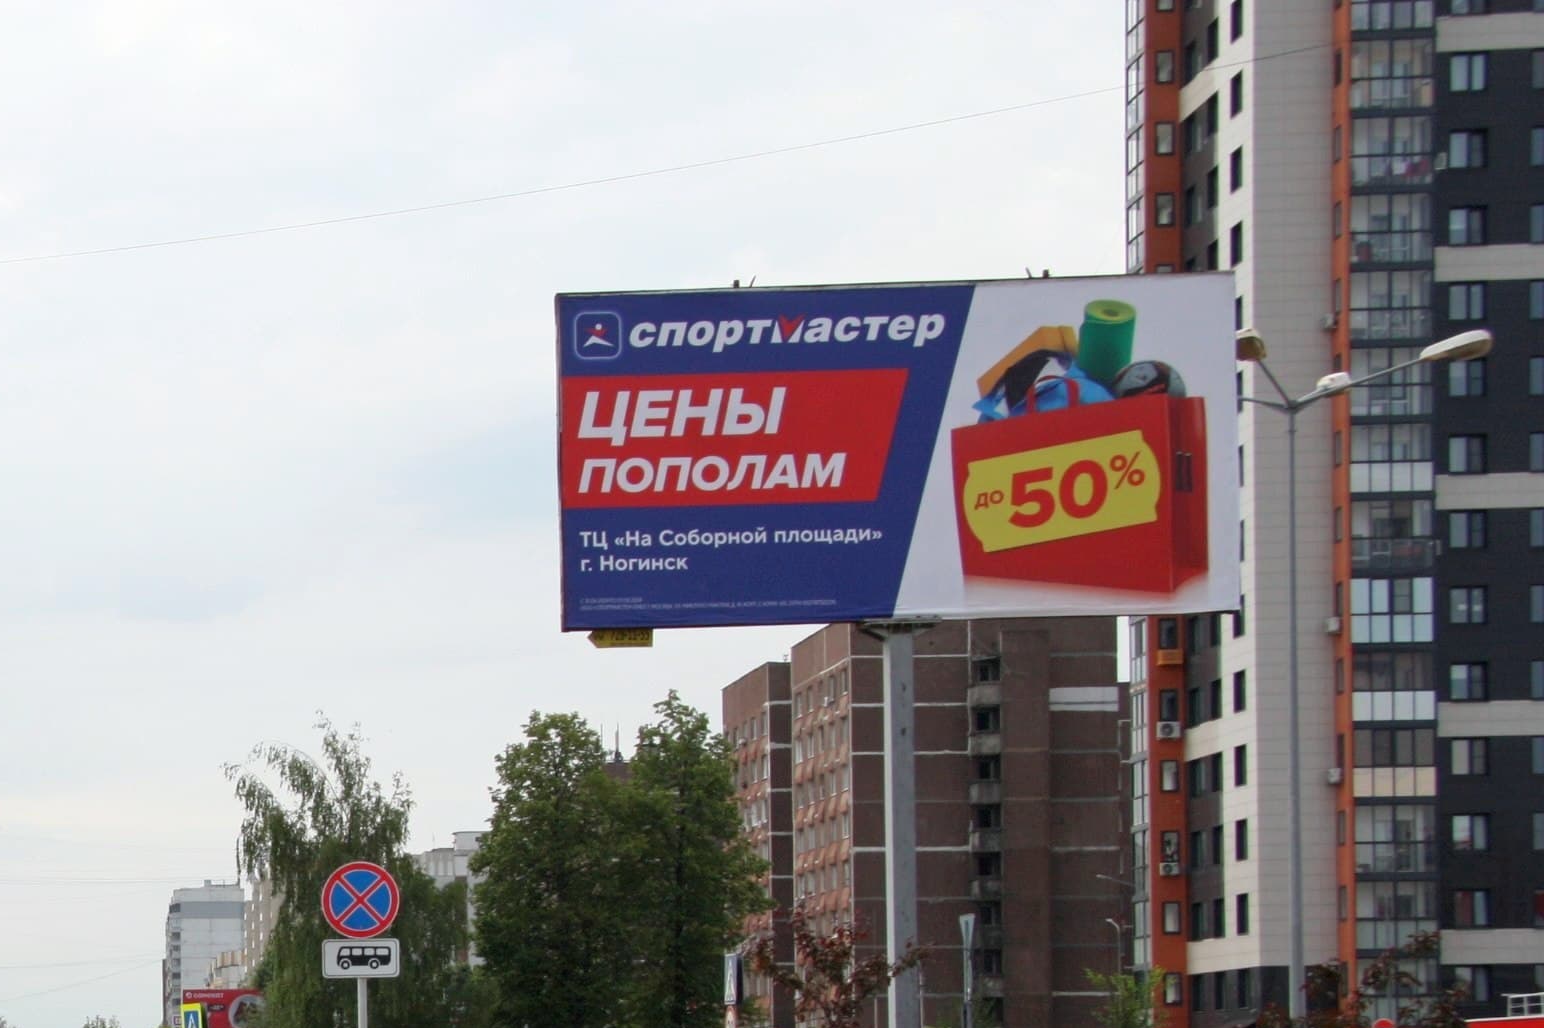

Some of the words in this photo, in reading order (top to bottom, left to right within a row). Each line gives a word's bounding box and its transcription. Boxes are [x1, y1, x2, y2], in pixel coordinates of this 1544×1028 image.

[628, 312, 946, 353] спортмастер
[577, 386, 787, 445] ЦЕНЫ
[577, 452, 847, 494] ПОПОЛАМ
[973, 488, 1005, 511] до
[1008, 450, 1146, 529] 50%
[579, 531, 608, 550] ТЦ
[614, 530, 652, 547] «На
[659, 526, 767, 550] Соборной
[774, 527, 883, 545] площади»
[580, 558, 593, 572] г.
[600, 555, 689, 572] Ногинск
